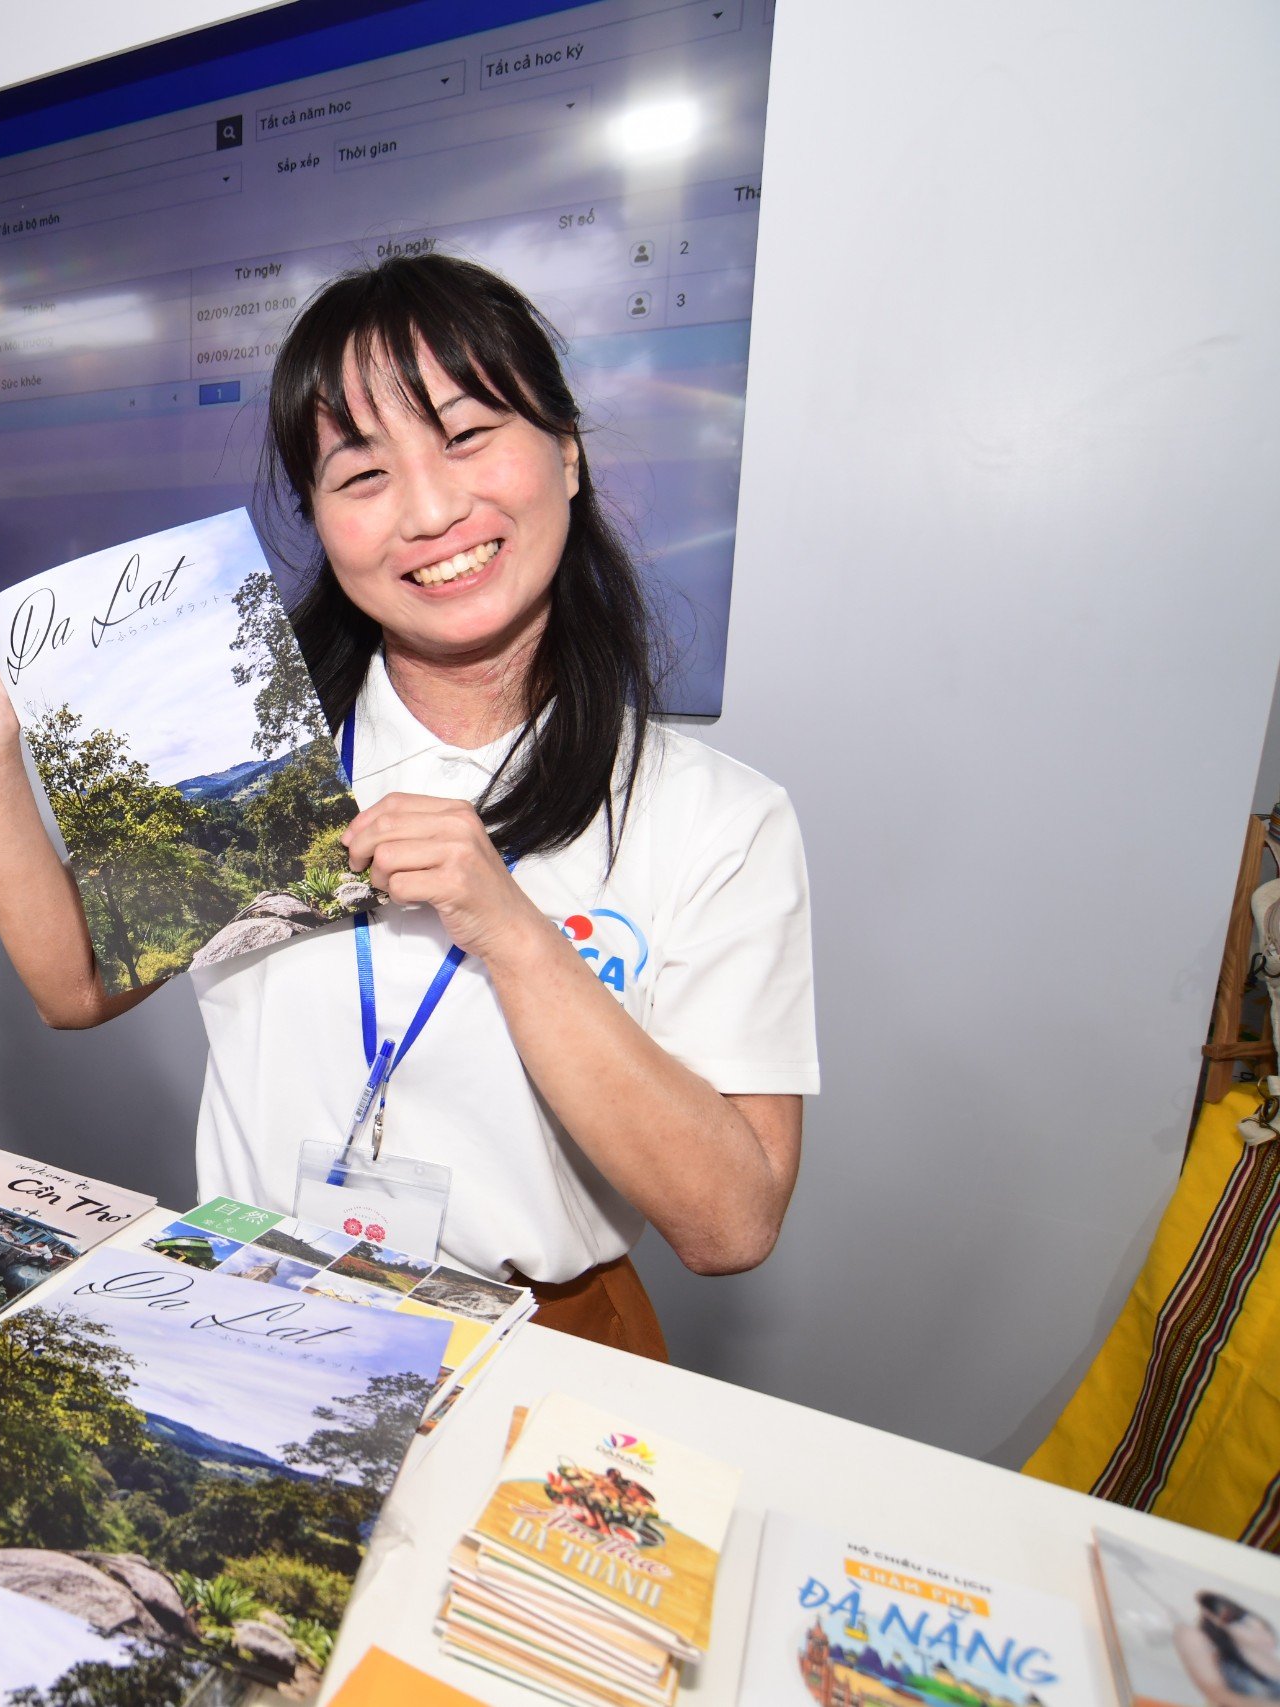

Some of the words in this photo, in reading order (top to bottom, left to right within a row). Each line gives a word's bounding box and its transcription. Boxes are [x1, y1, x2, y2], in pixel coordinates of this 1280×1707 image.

[513, 54, 531, 71] cả
[282, 109, 296, 125] cả
[299, 106, 325, 122] năm
[369, 140, 397, 159] gian
[680, 240, 689, 256] 2
[234, 267, 252, 281] Từ
[197, 302, 260, 322] 02/09/2021
[264, 296, 297, 311] 08:00
[676, 293, 686, 308] 3
[197, 345, 260, 365] 09/09/2021
[66, 1195, 132, 1222] Thơ
[798, 1576, 867, 1628] ĐÀ
